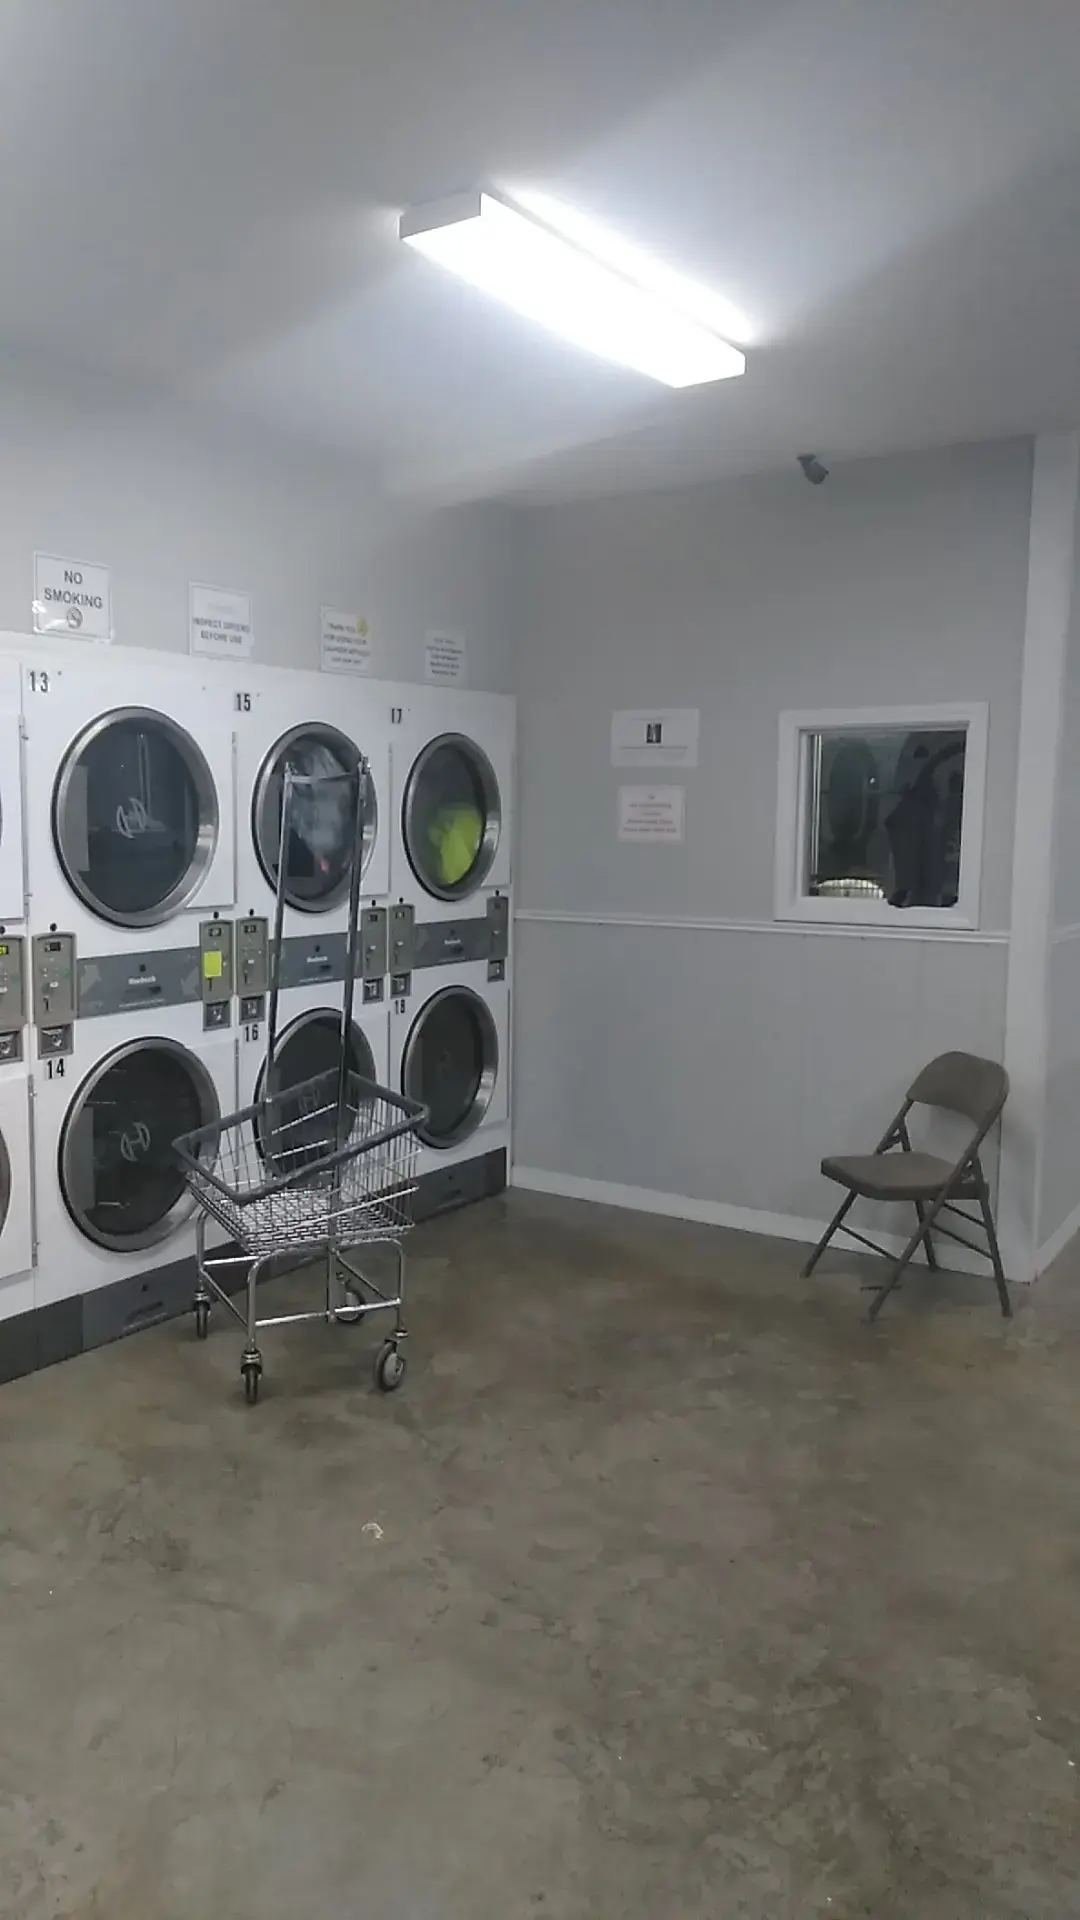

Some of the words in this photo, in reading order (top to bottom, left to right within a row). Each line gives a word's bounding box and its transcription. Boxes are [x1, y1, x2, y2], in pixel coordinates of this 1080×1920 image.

[63, 570, 83, 585] NO
[44, 587, 103, 610] SMOKING
[29, 671, 49, 693] 13
[236, 692, 251, 711] 15
[391, 708, 402, 724] 17
[395, 999, 406, 1014] 18
[245, 1024, 259, 1042] 16
[47, 1058, 65, 1079] 14
